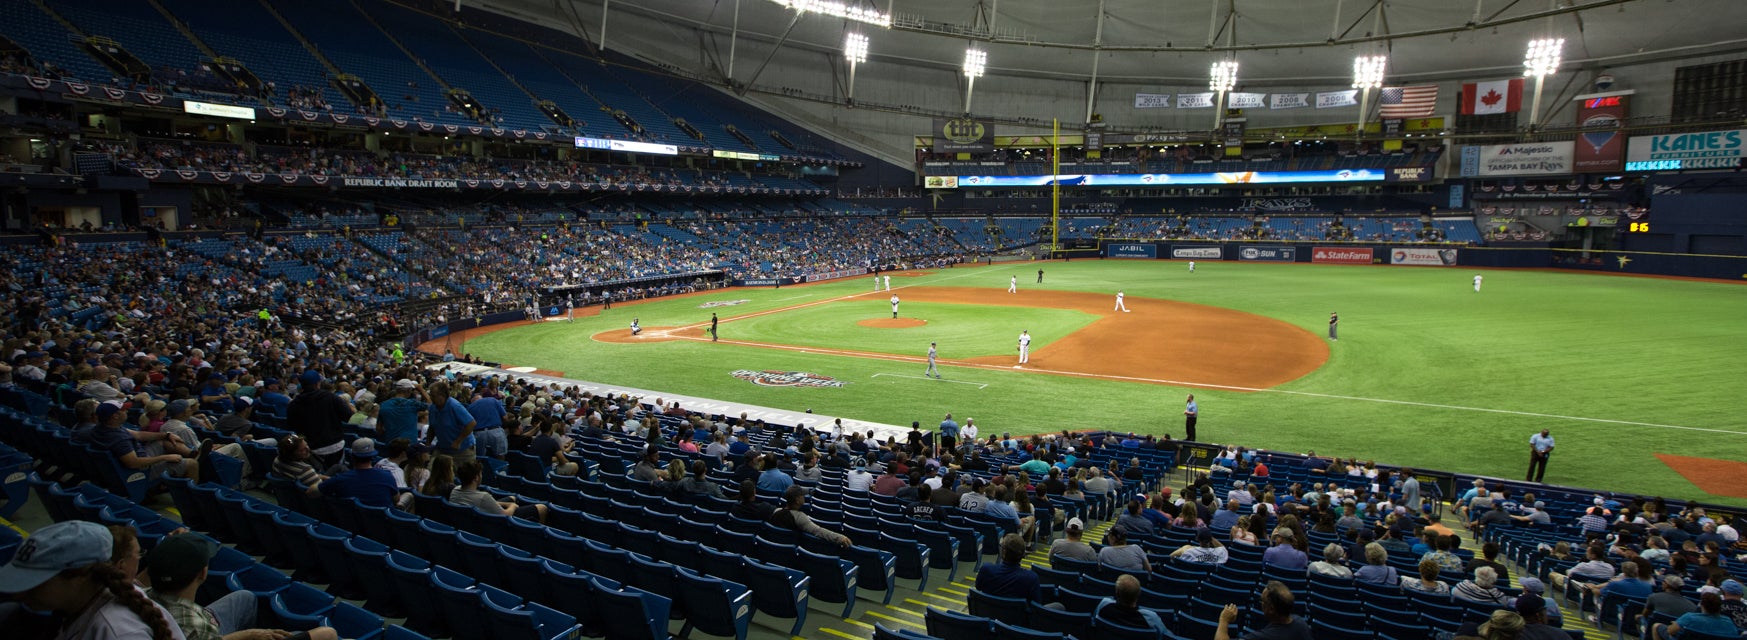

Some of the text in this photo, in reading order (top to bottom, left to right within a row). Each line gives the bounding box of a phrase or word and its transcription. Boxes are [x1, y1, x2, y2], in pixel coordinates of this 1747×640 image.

[1651, 131, 1742, 152] KANE'S
[1514, 146, 1553, 155] Majestic
[1652, 149, 1736, 159] FURNITURE
[344, 179, 383, 187] REPUBLIC
[408, 180, 433, 188] DRAFT
[1175, 248, 1219, 257] Tampa Bay Times
[913, 506, 934, 514] ARCHER
[961, 501, 978, 511] 42
